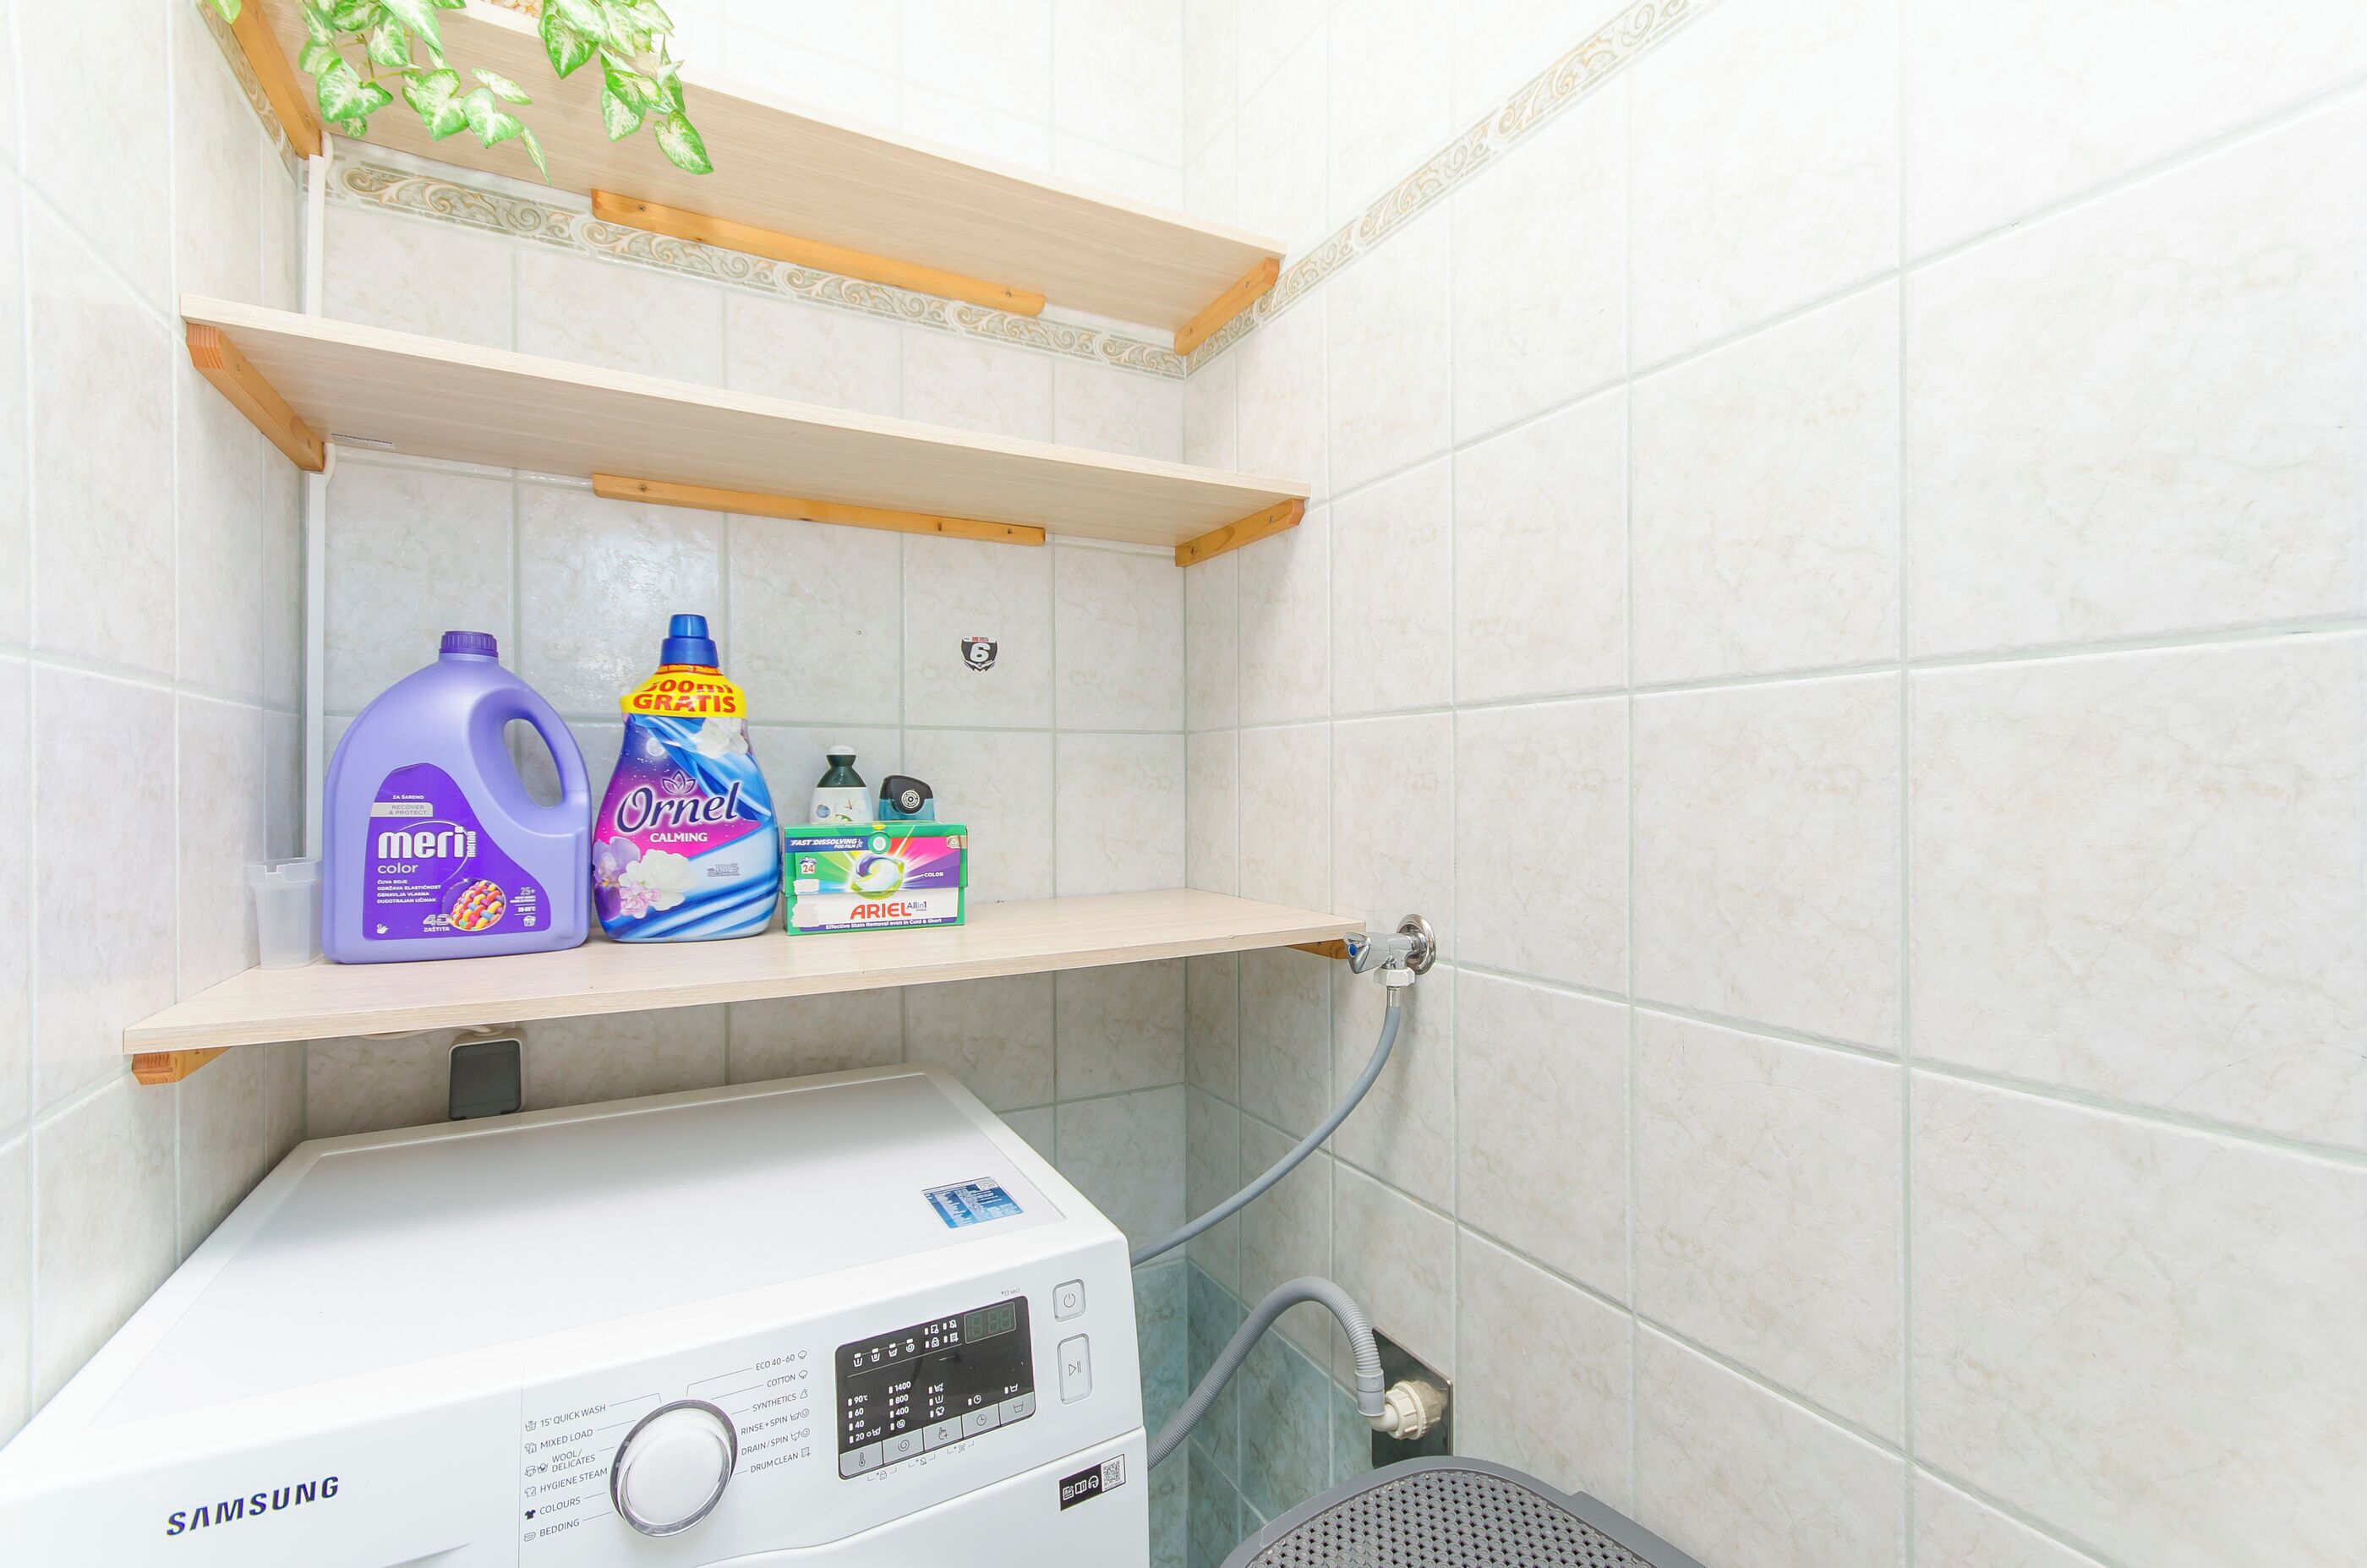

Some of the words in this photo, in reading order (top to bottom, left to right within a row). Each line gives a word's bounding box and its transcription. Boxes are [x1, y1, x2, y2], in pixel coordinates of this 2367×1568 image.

[970, 642, 991, 662] 6
[632, 693, 736, 713] GRATIS
[616, 781, 741, 833] Ornel
[378, 826, 464, 859] meri
[467, 831, 476, 858] merino
[649, 832, 708, 843] CALMING
[377, 862, 418, 874] color
[802, 864, 814, 873] 24
[423, 914, 451, 926] 4D
[850, 902, 911, 921] ARIEL
[756, 1360, 771, 1371] ECO
[767, 1374, 796, 1388] COTTON
[894, 1380, 911, 1392] 1400
[752, 1393, 797, 1412] SYNTHETICS
[895, 1394, 909, 1404] 800
[553, 1410, 580, 1425] QUICK
[581, 1404, 606, 1418] WASH
[854, 1407, 864, 1417] 60
[895, 1406, 910, 1416] 400
[855, 1419, 865, 1429] 40
[540, 1435, 568, 1450] MIXED
[570, 1429, 593, 1442] LOAD
[855, 1432, 865, 1442] 20
[551, 1454, 596, 1472] DELICATES
[750, 1459, 774, 1473] DRUM
[774, 1451, 799, 1466] CLEAN
[539, 1475, 578, 1494] HYGIENE
[579, 1467, 608, 1483] STEAM
[167, 1476, 339, 1536] SAMSUNG
[539, 1496, 581, 1516] COLOURS
[539, 1518, 580, 1538] BEDDING
